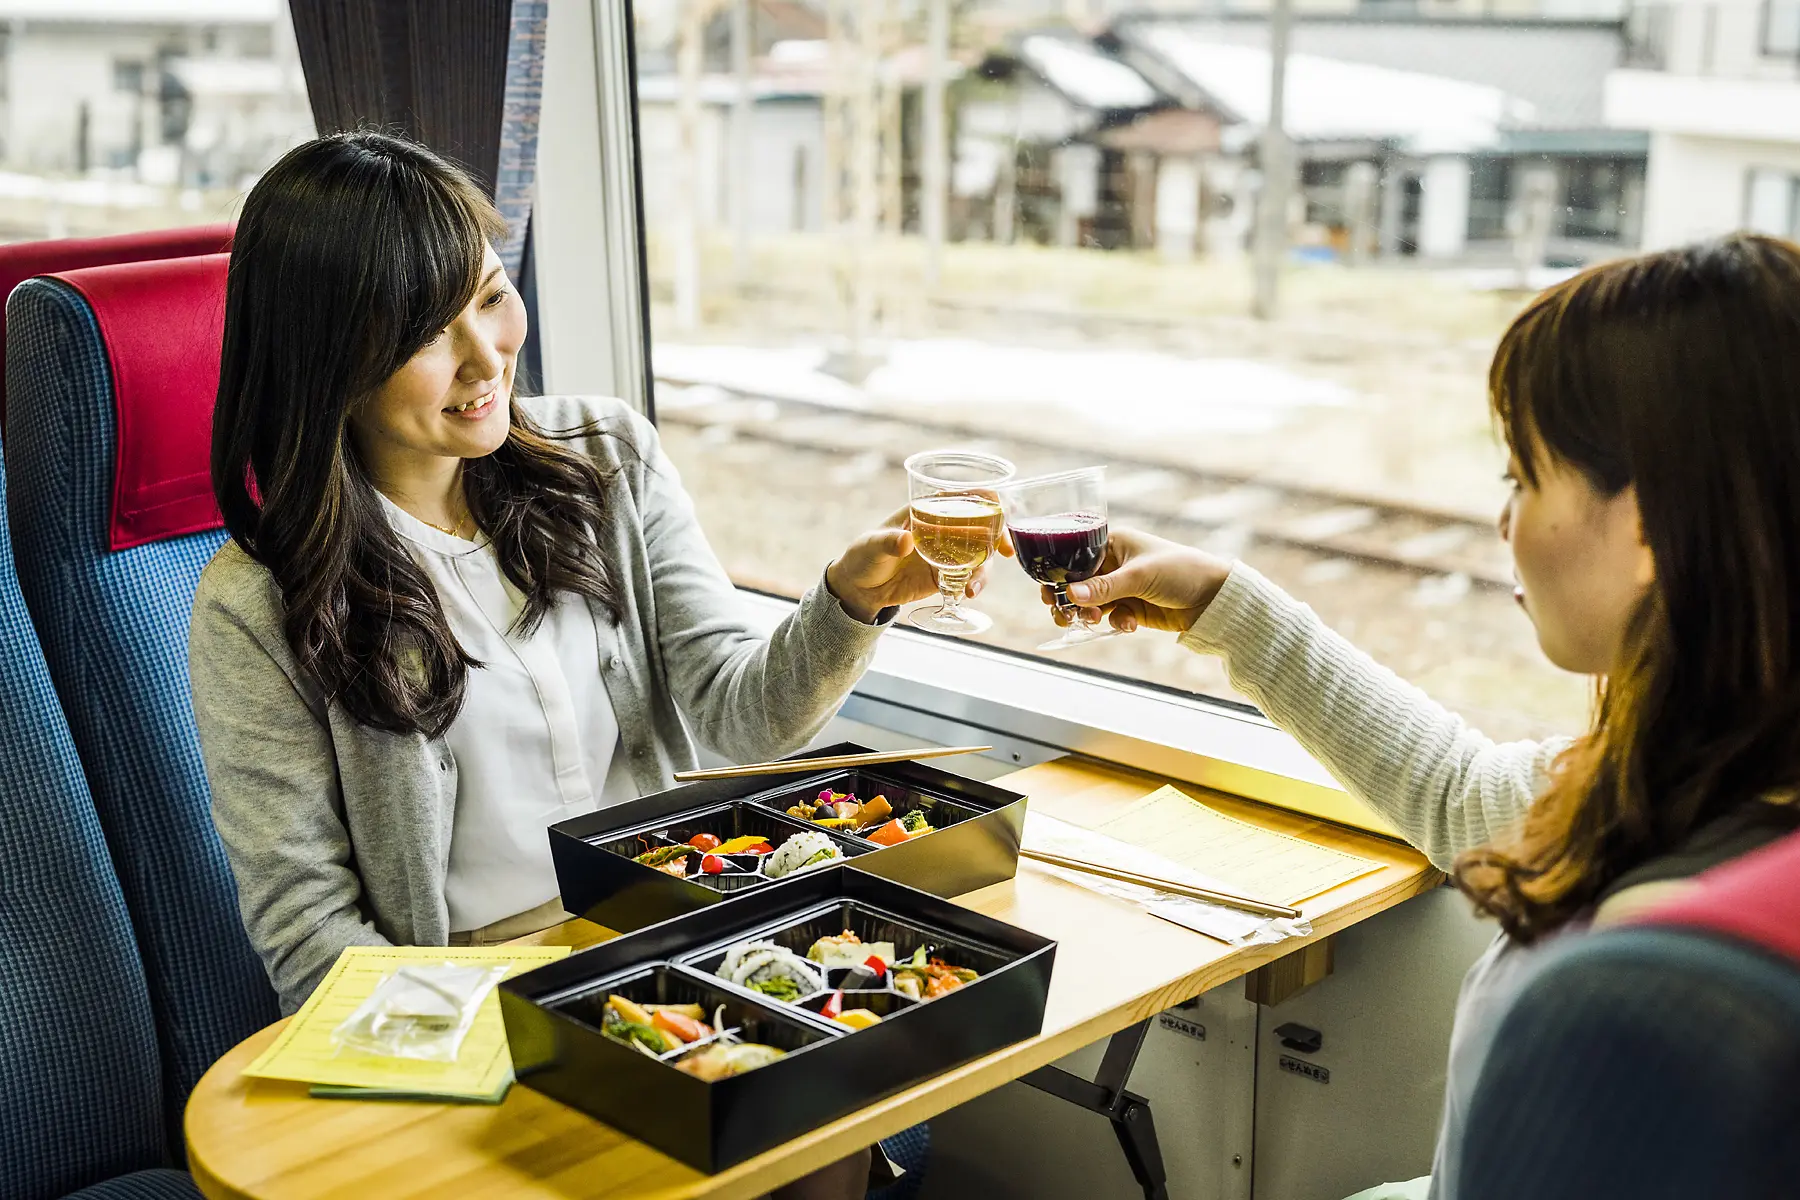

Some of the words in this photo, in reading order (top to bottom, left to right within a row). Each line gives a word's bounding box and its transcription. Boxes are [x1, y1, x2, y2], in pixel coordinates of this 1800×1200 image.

[1167, 1018, 1197, 1036] せんぬき
[1288, 1059, 1320, 1079] せんぬき
